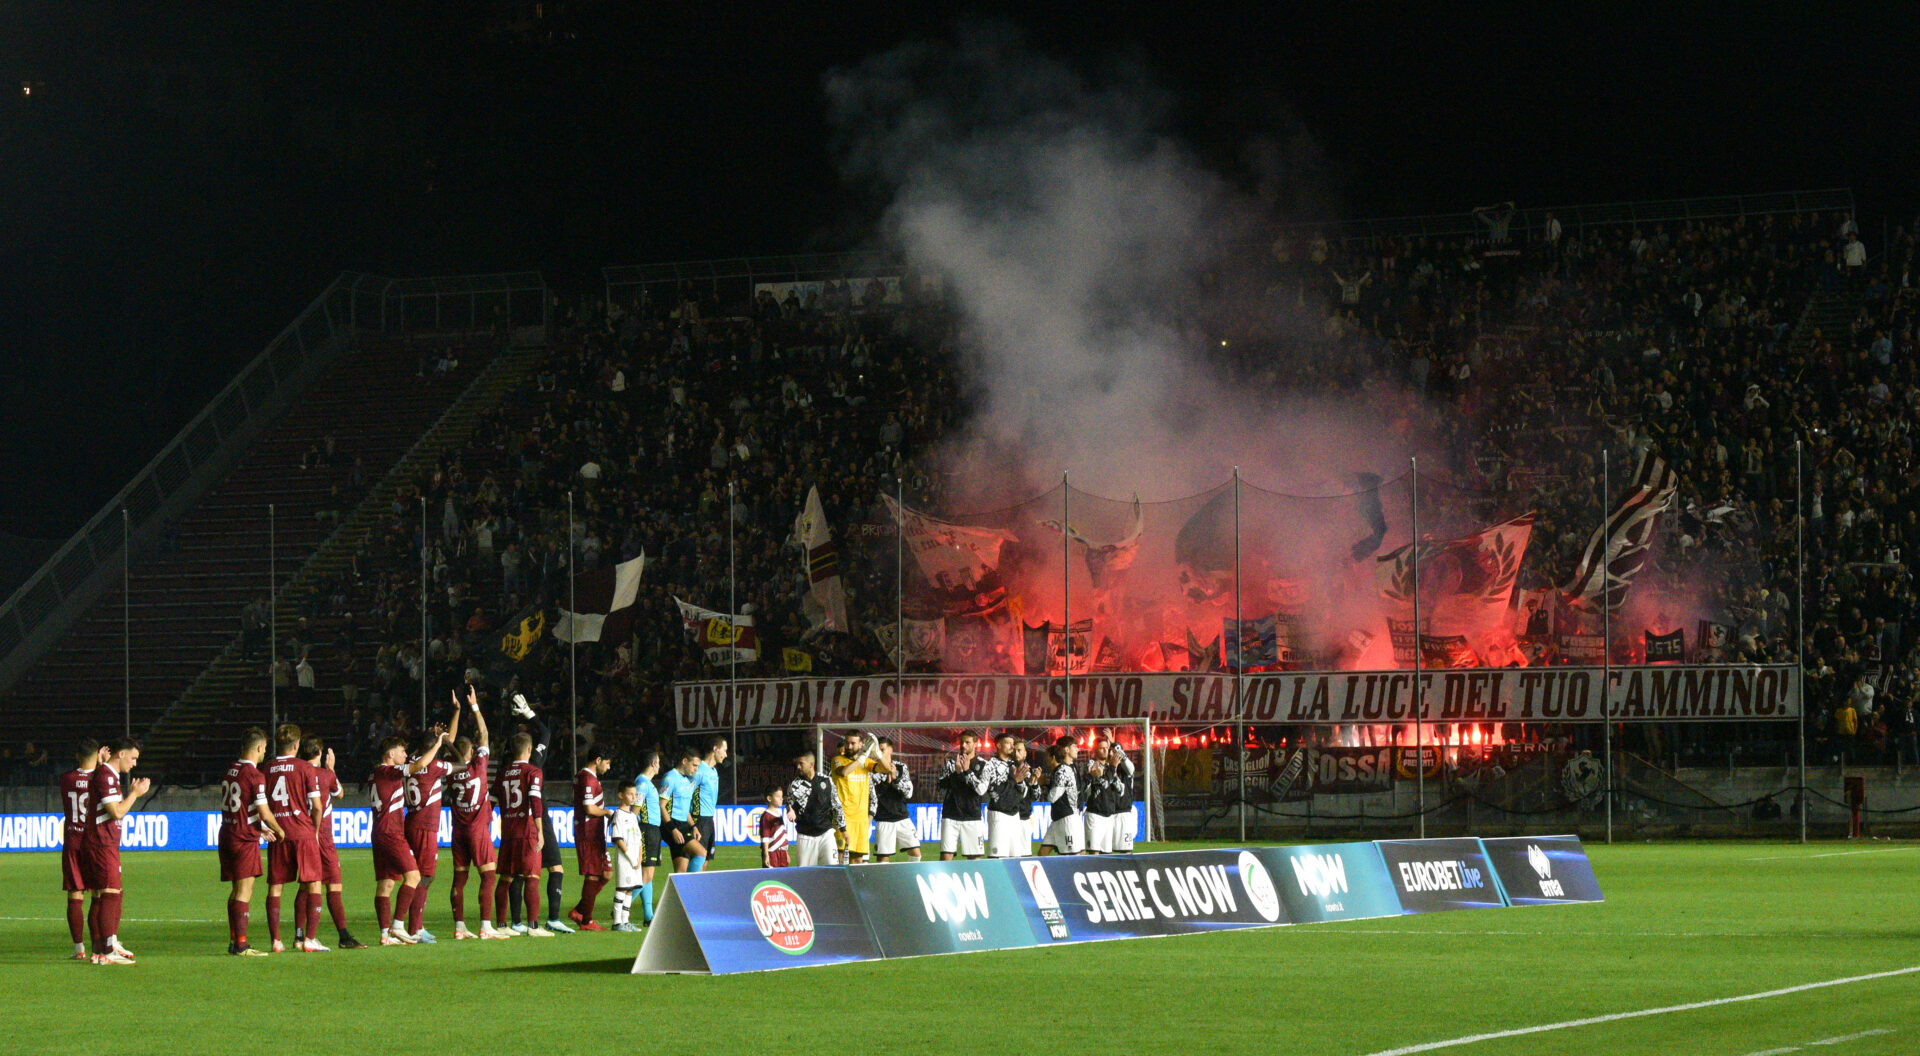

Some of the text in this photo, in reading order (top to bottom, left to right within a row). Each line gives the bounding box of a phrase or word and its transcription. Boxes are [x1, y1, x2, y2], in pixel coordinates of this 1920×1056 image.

[681, 683, 766, 729] UNITI
[771, 679, 870, 724] DALLO
[877, 678, 996, 722] STESSO
[1287, 676, 1330, 720] LA
[1341, 674, 1433, 720] LUCE
[1441, 672, 1507, 719] DEL
[1519, 671, 1591, 718] TUO
[1600, 668, 1790, 718] CAMMINO!
[221, 779, 242, 813] 28
[271, 775, 290, 807] 4
[452, 777, 481, 808] 27
[502, 779, 523, 809] 13
[1064, 835, 1074, 846] 14
[1290, 853, 1348, 897] NOW
[916, 871, 990, 923] NOW
[1073, 864, 1238, 923] SERIE C NOW
[752, 898, 814, 938] Beretta
[1041, 909, 1060, 920] SERIE
[784, 934, 800, 946] 1812
[1050, 924, 1068, 938] NOW
